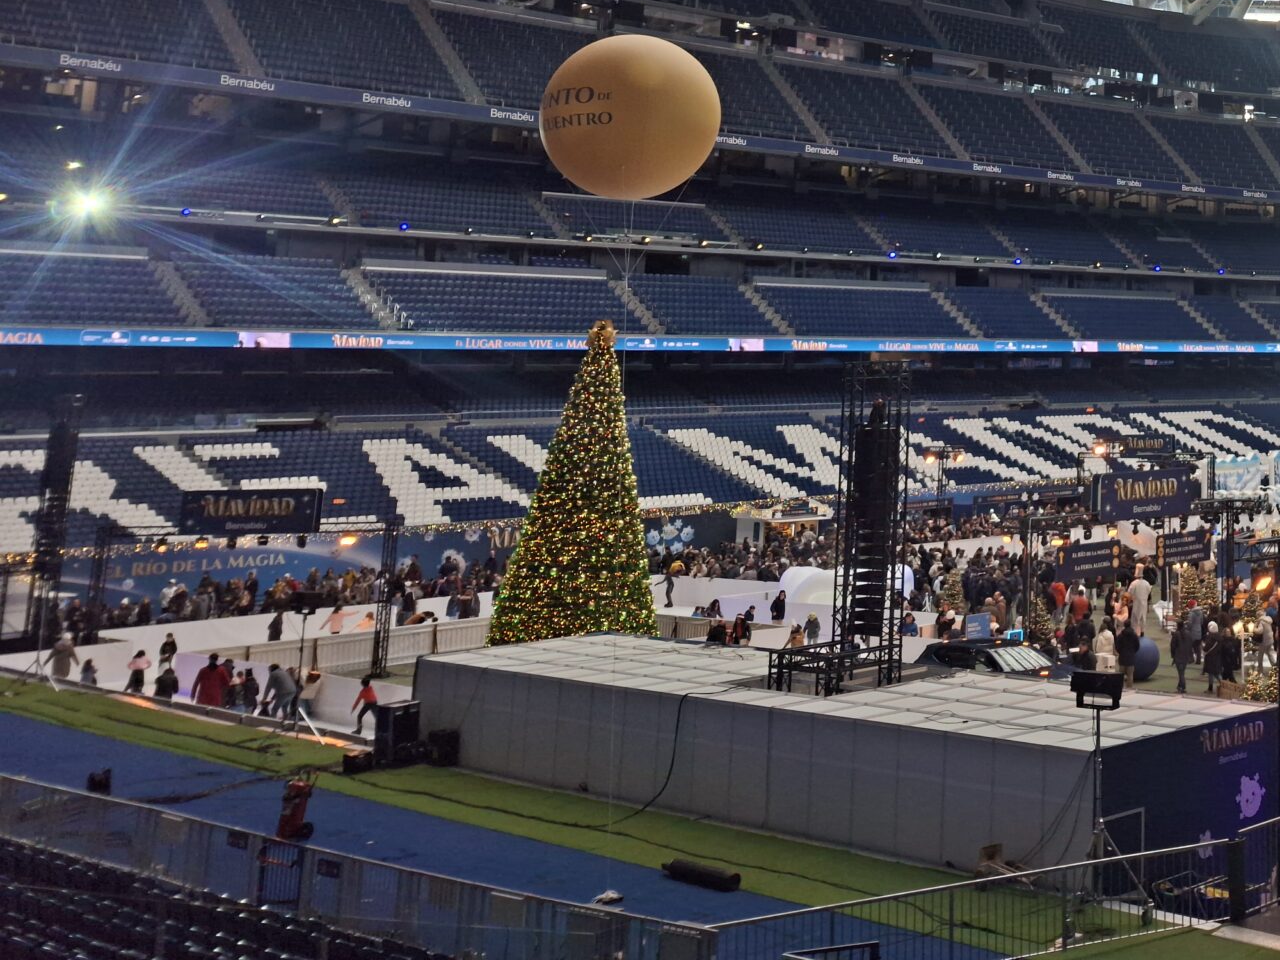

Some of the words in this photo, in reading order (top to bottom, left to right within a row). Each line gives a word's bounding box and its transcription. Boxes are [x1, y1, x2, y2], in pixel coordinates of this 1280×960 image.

[60, 54, 122, 72] Bernabéu
[220, 74, 275, 92] Bernabéu
[362, 92, 411, 108] Bernabéu
[597, 91, 613, 101] DE
[490, 108, 535, 123] Bernabéu
[716, 135, 747, 146] ernabéu
[805, 144, 839, 156] Bernabéu
[892, 154, 924, 166] Bernabéu
[973, 162, 1002, 173] Bernabéu
[1047, 171, 1075, 182] Bernabéu
[0, 332, 43, 344] AGIA
[465, 338, 503, 349] LUGAR
[528, 339, 553, 349] VIVE
[885, 342, 911, 350] LUGAR
[928, 342, 946, 350] VIVE
[954, 343, 979, 351] MAGIA
[1132, 504, 1162, 514] Bernabéu
[131, 558, 167, 577] RÍO
[172, 559, 197, 574] DE
[201, 558, 223, 571] LA
[227, 552, 287, 569] MAGIA
